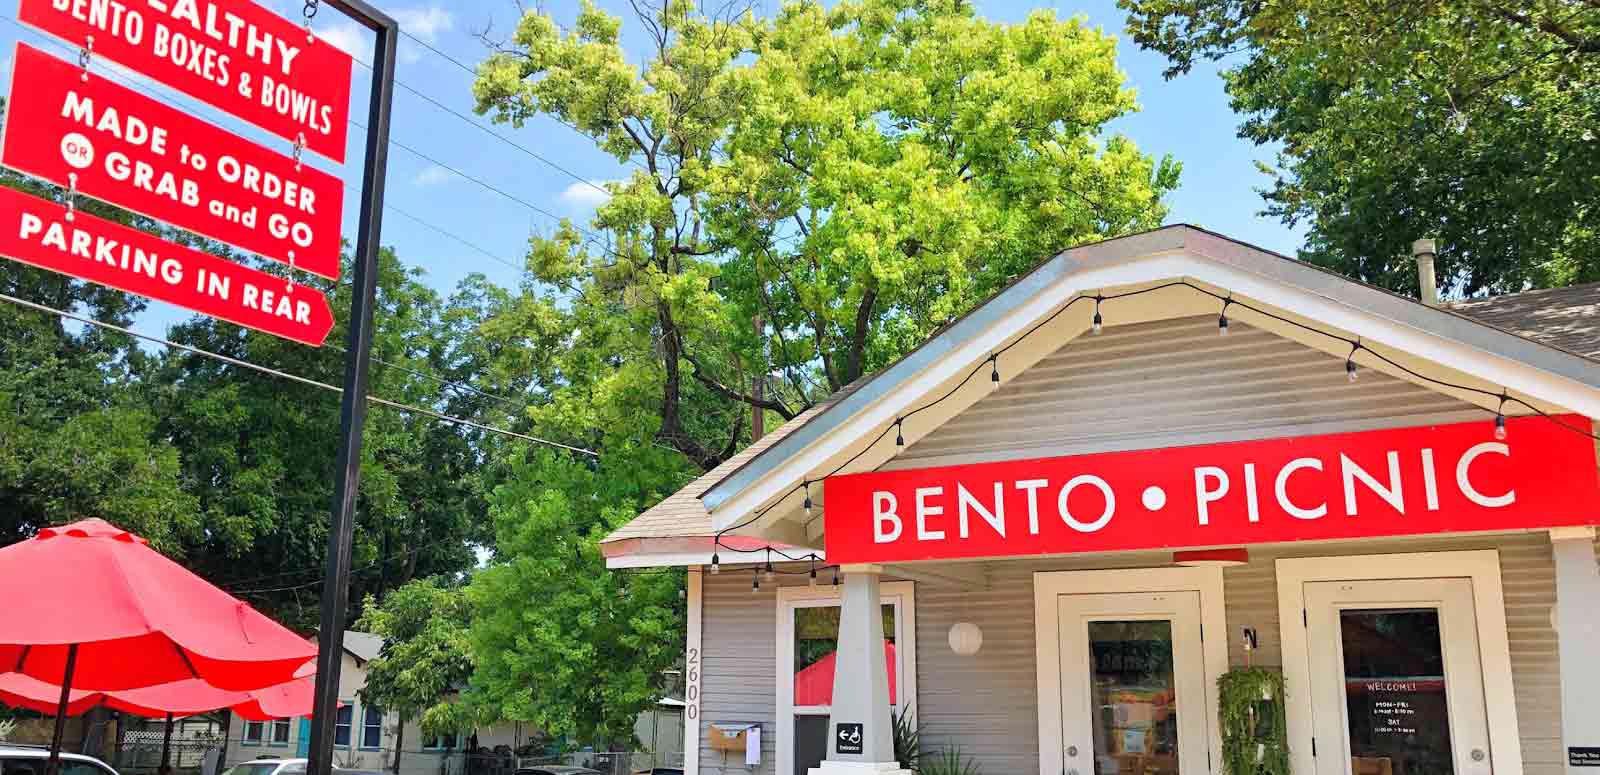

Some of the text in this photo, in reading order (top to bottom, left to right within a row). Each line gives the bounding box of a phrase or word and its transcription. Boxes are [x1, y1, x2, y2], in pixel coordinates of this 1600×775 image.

[153, 23, 231, 88] BOXES
[238, 71, 253, 99] &
[261, 75, 333, 135] BOWLS
[61, 91, 315, 215] MADE to ORDER
[66, 142, 314, 248] OR GRAB and GO
[19, 212, 312, 325] PARKING IN REAR
[872, 441, 1516, 544] BENTO PICNIC
[687, 648, 698, 720] 2600
[1367, 682, 1417, 691] WELCOME!
